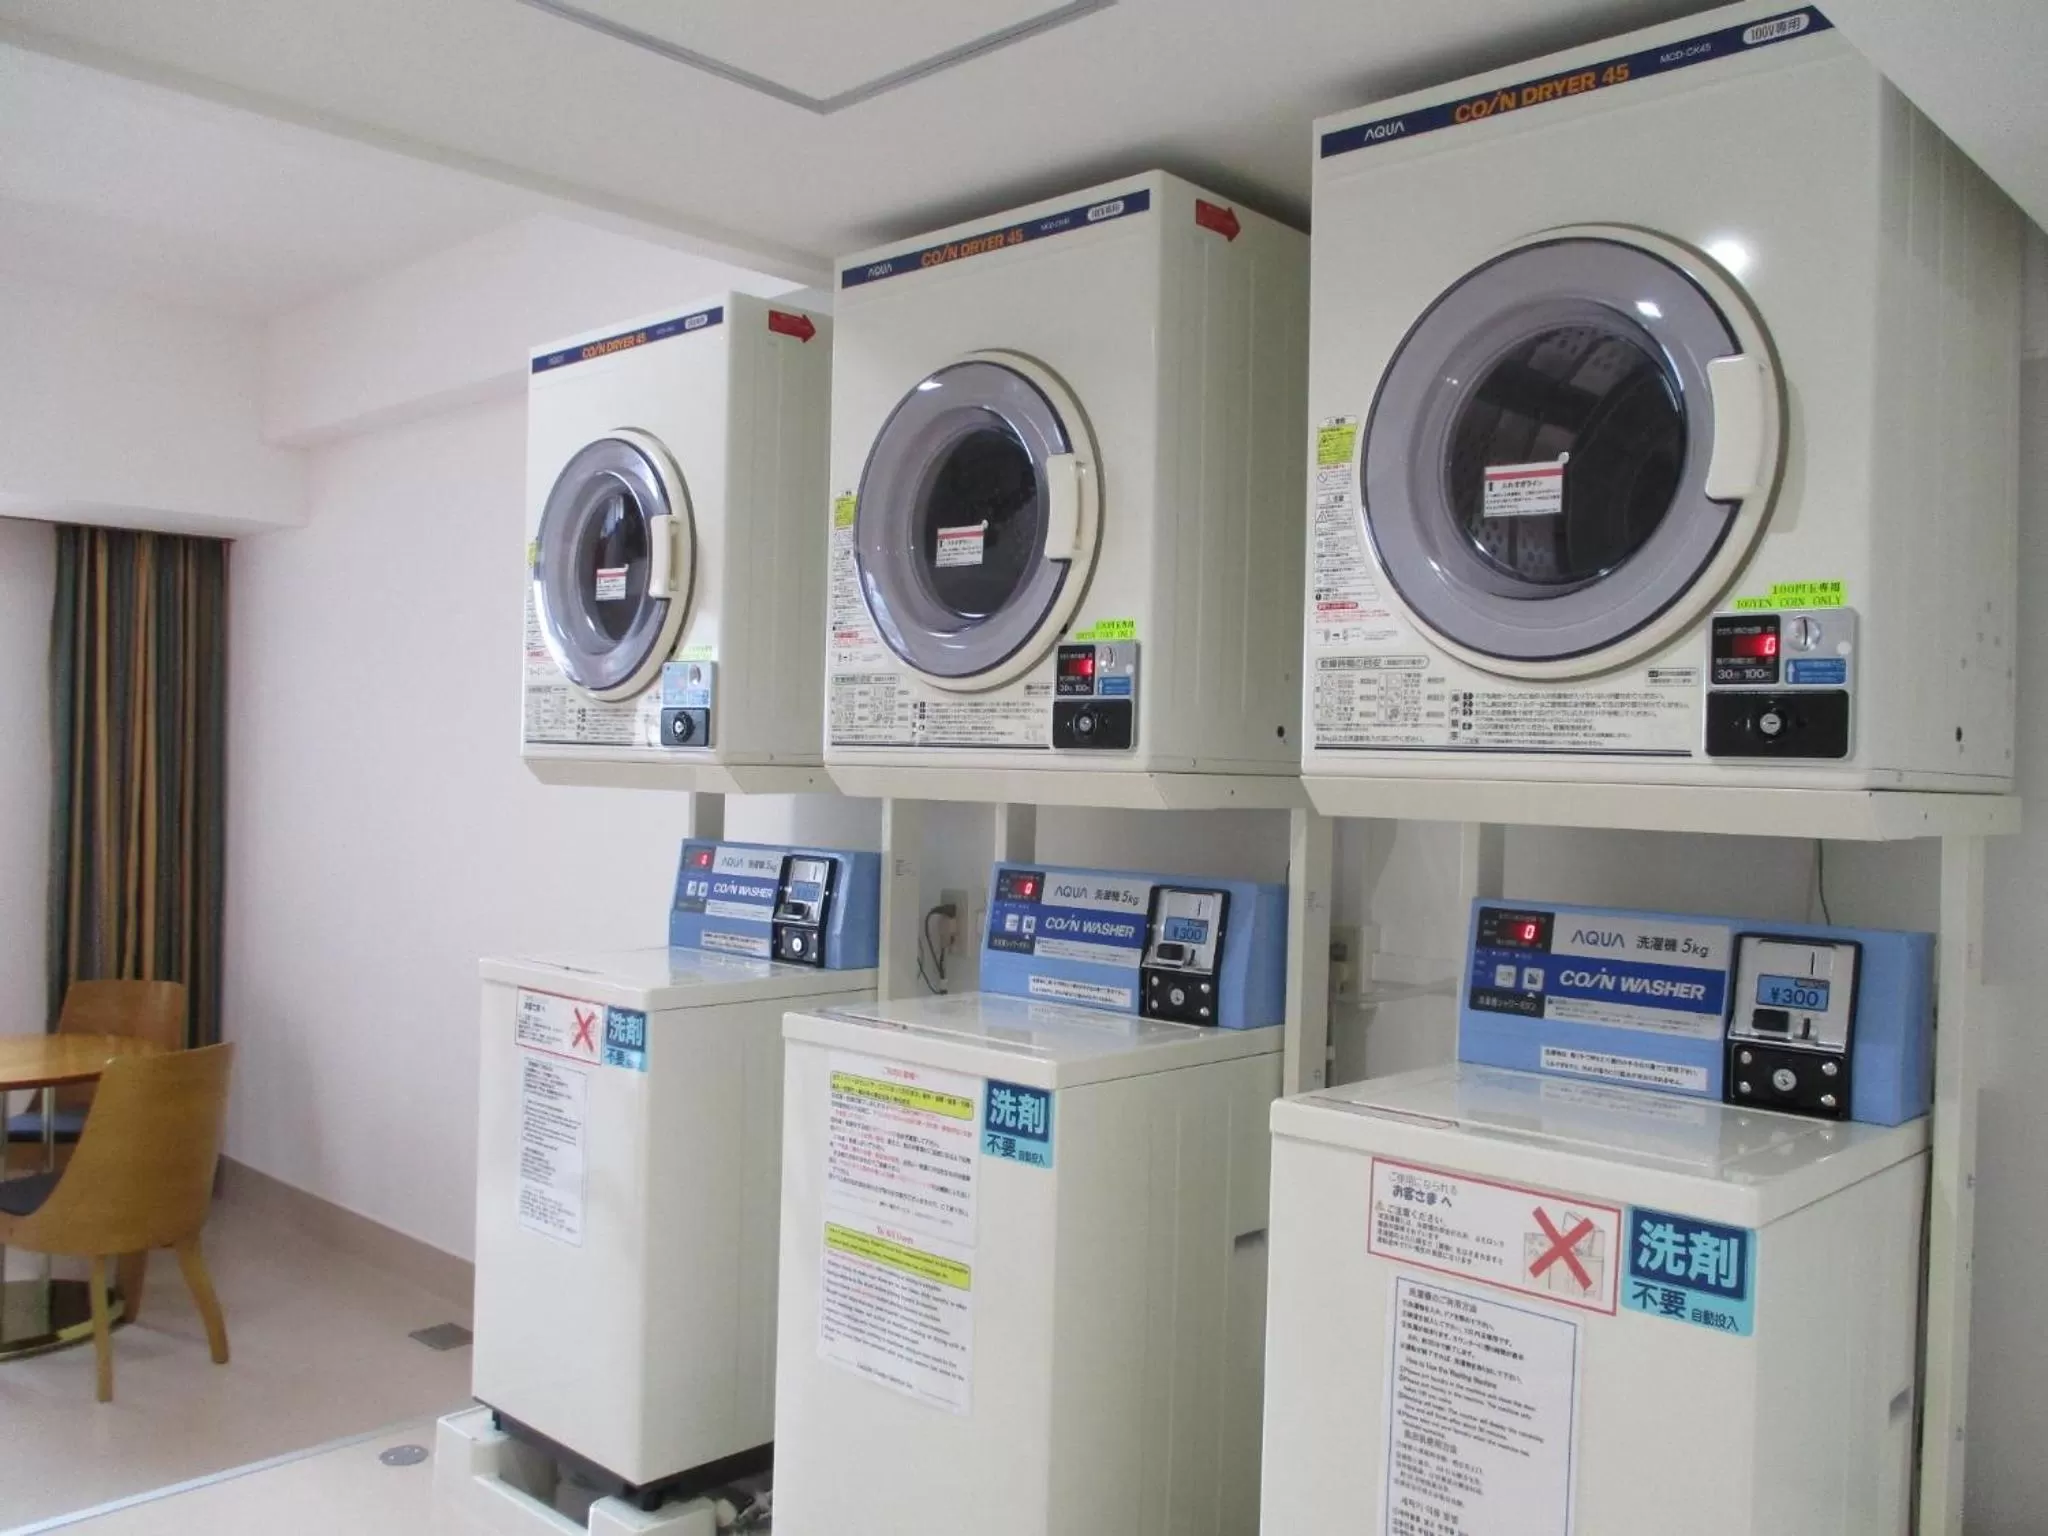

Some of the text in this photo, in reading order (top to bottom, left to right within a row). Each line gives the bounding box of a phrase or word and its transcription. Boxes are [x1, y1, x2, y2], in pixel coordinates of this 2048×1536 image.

[1365, 119, 1405, 141] AQUA
[1521, 72, 1596, 106] DRYER
[1601, 64, 1630, 86] 45
[960, 234, 1005, 257] DRYER
[1007, 228, 1025, 245] 45
[1812, 596, 1842, 606] ONLY
[1763, 636, 1777, 655] 0
[738, 884, 774, 899] WASHER
[1053, 885, 1088, 899] AQUA
[1082, 920, 1136, 939] WASHER
[1523, 924, 1536, 940] 0
[1570, 929, 1625, 949] AQUA
[1636, 935, 1678, 953] 洗濯機
[1681, 938, 1710, 958] 5kg
[1620, 975, 1706, 1001] WASHER
[1769, 986, 1820, 1007] ¥300
[988, 1087, 1046, 1134] 洗剤
[986, 1133, 1017, 1159] 不要
[1637, 1219, 1740, 1289] 洗剤
[1631, 1280, 1740, 1333] 不要 自動投入
